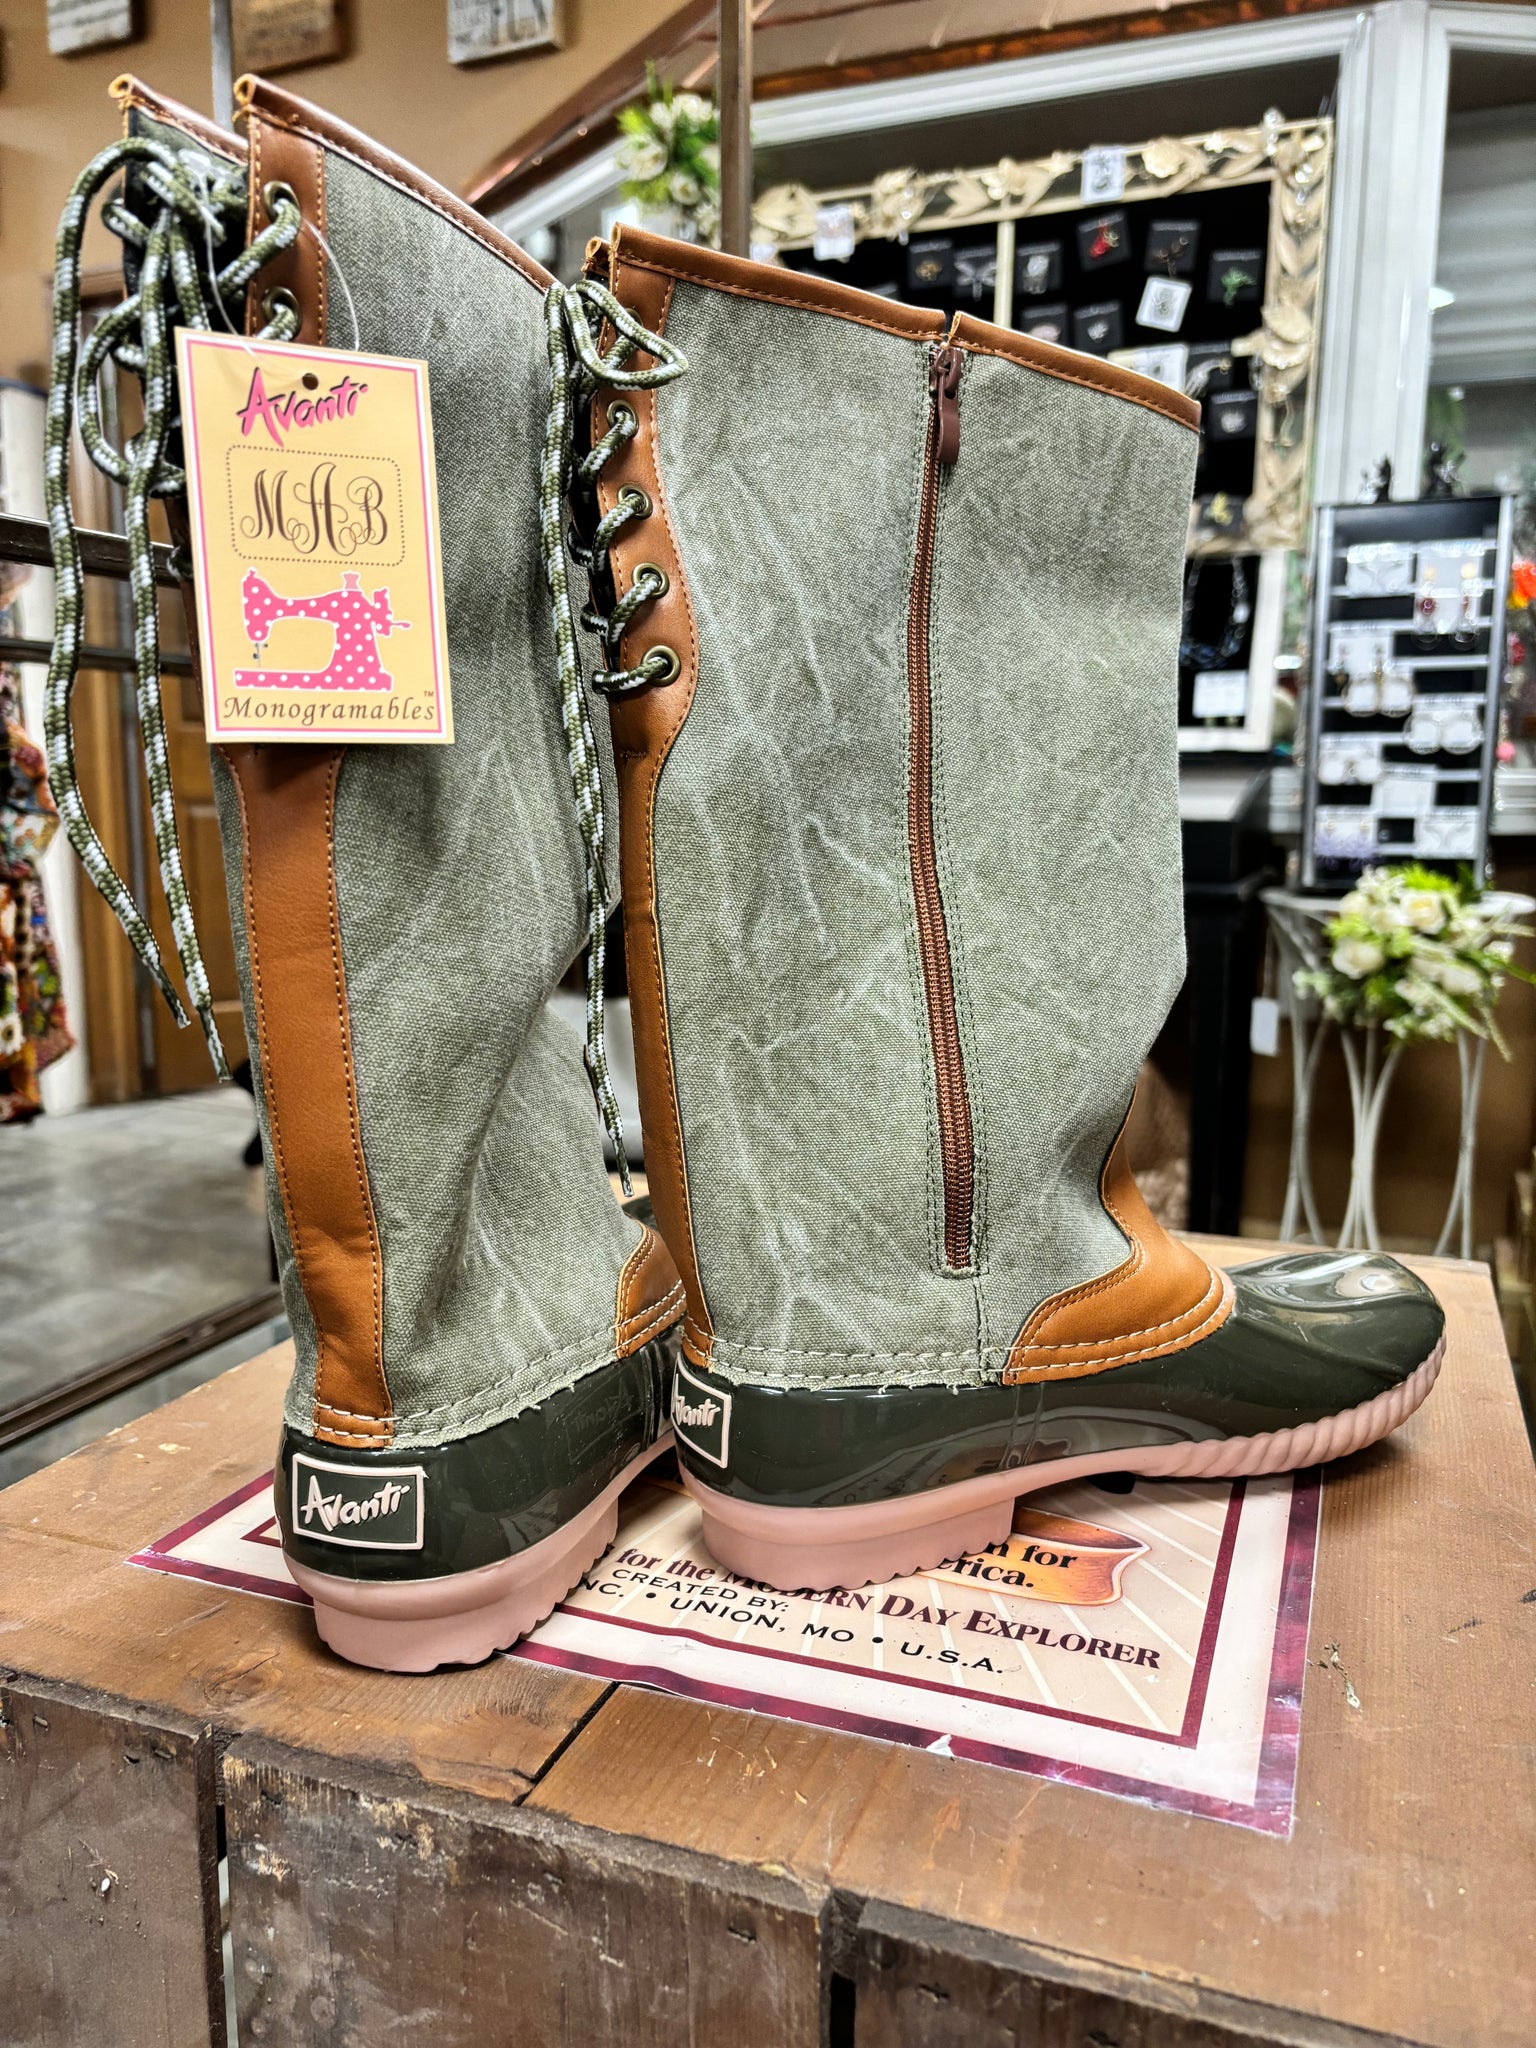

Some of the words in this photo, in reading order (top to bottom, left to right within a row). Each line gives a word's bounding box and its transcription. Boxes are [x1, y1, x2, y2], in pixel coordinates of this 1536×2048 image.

[236, 367, 369, 448] Avanti
[223, 696, 435, 727] Monogramables
[300, 1475, 410, 1532] Avanti
[1020, 1544, 1078, 1569] for
[612, 1569, 739, 1600] CREATED
[746, 1596, 789, 1613] BY:
[616, 1548, 663, 1570] for
[665, 1559, 716, 1582] the
[879, 1594, 961, 1626] DAY
[963, 1609, 1161, 1670] EXPLORER
[670, 1597, 786, 1633] UNION,
[801, 1623, 855, 1643] MO
[900, 1641, 1003, 1674] U.S.A.
